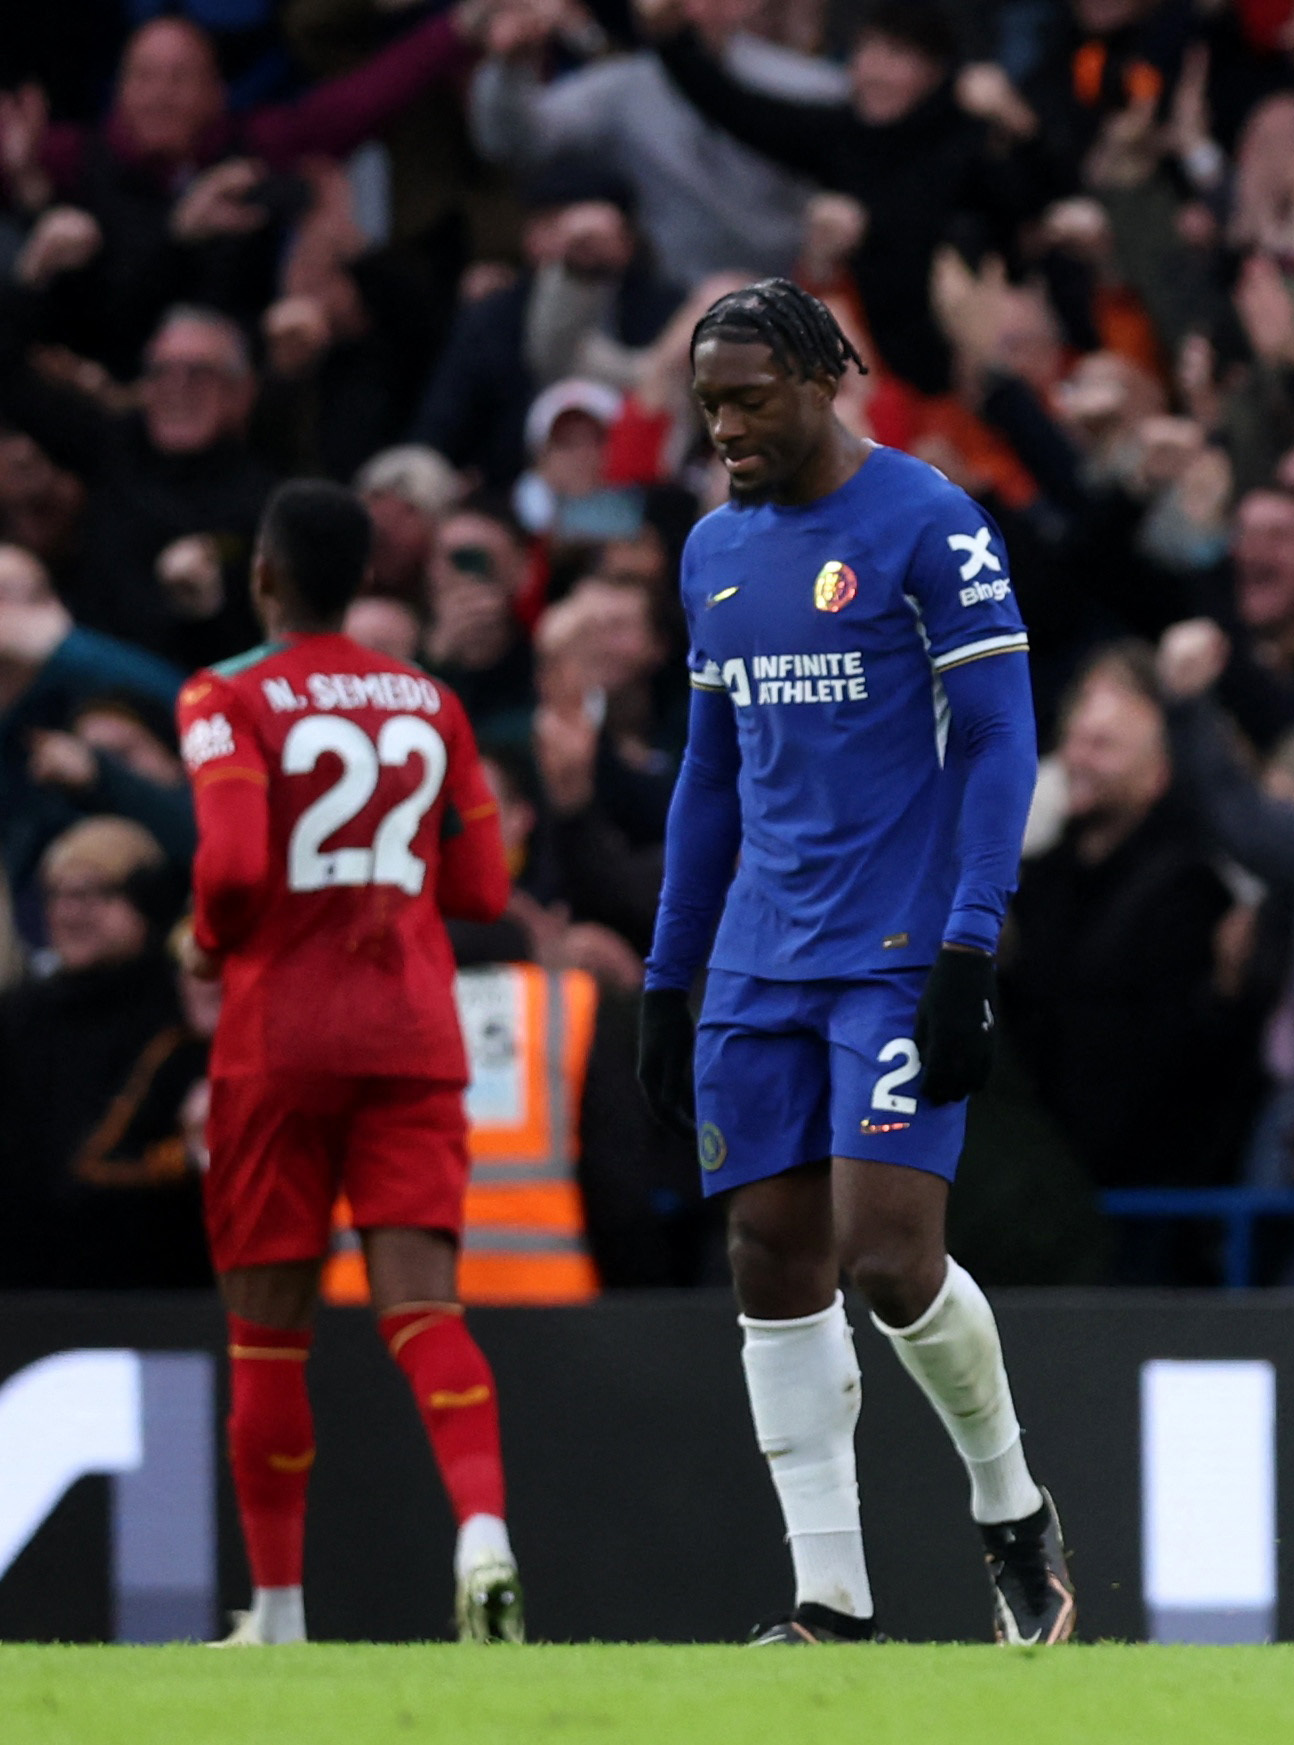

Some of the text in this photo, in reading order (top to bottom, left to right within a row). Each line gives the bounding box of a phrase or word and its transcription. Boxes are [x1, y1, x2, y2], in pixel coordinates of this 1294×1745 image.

[752, 651, 864, 679] INFINITE
[261, 672, 441, 716] N. SEMEDO
[757, 677, 868, 705] ATHLETE
[282, 714, 447, 896] 22
[871, 1037, 922, 1115] 2
